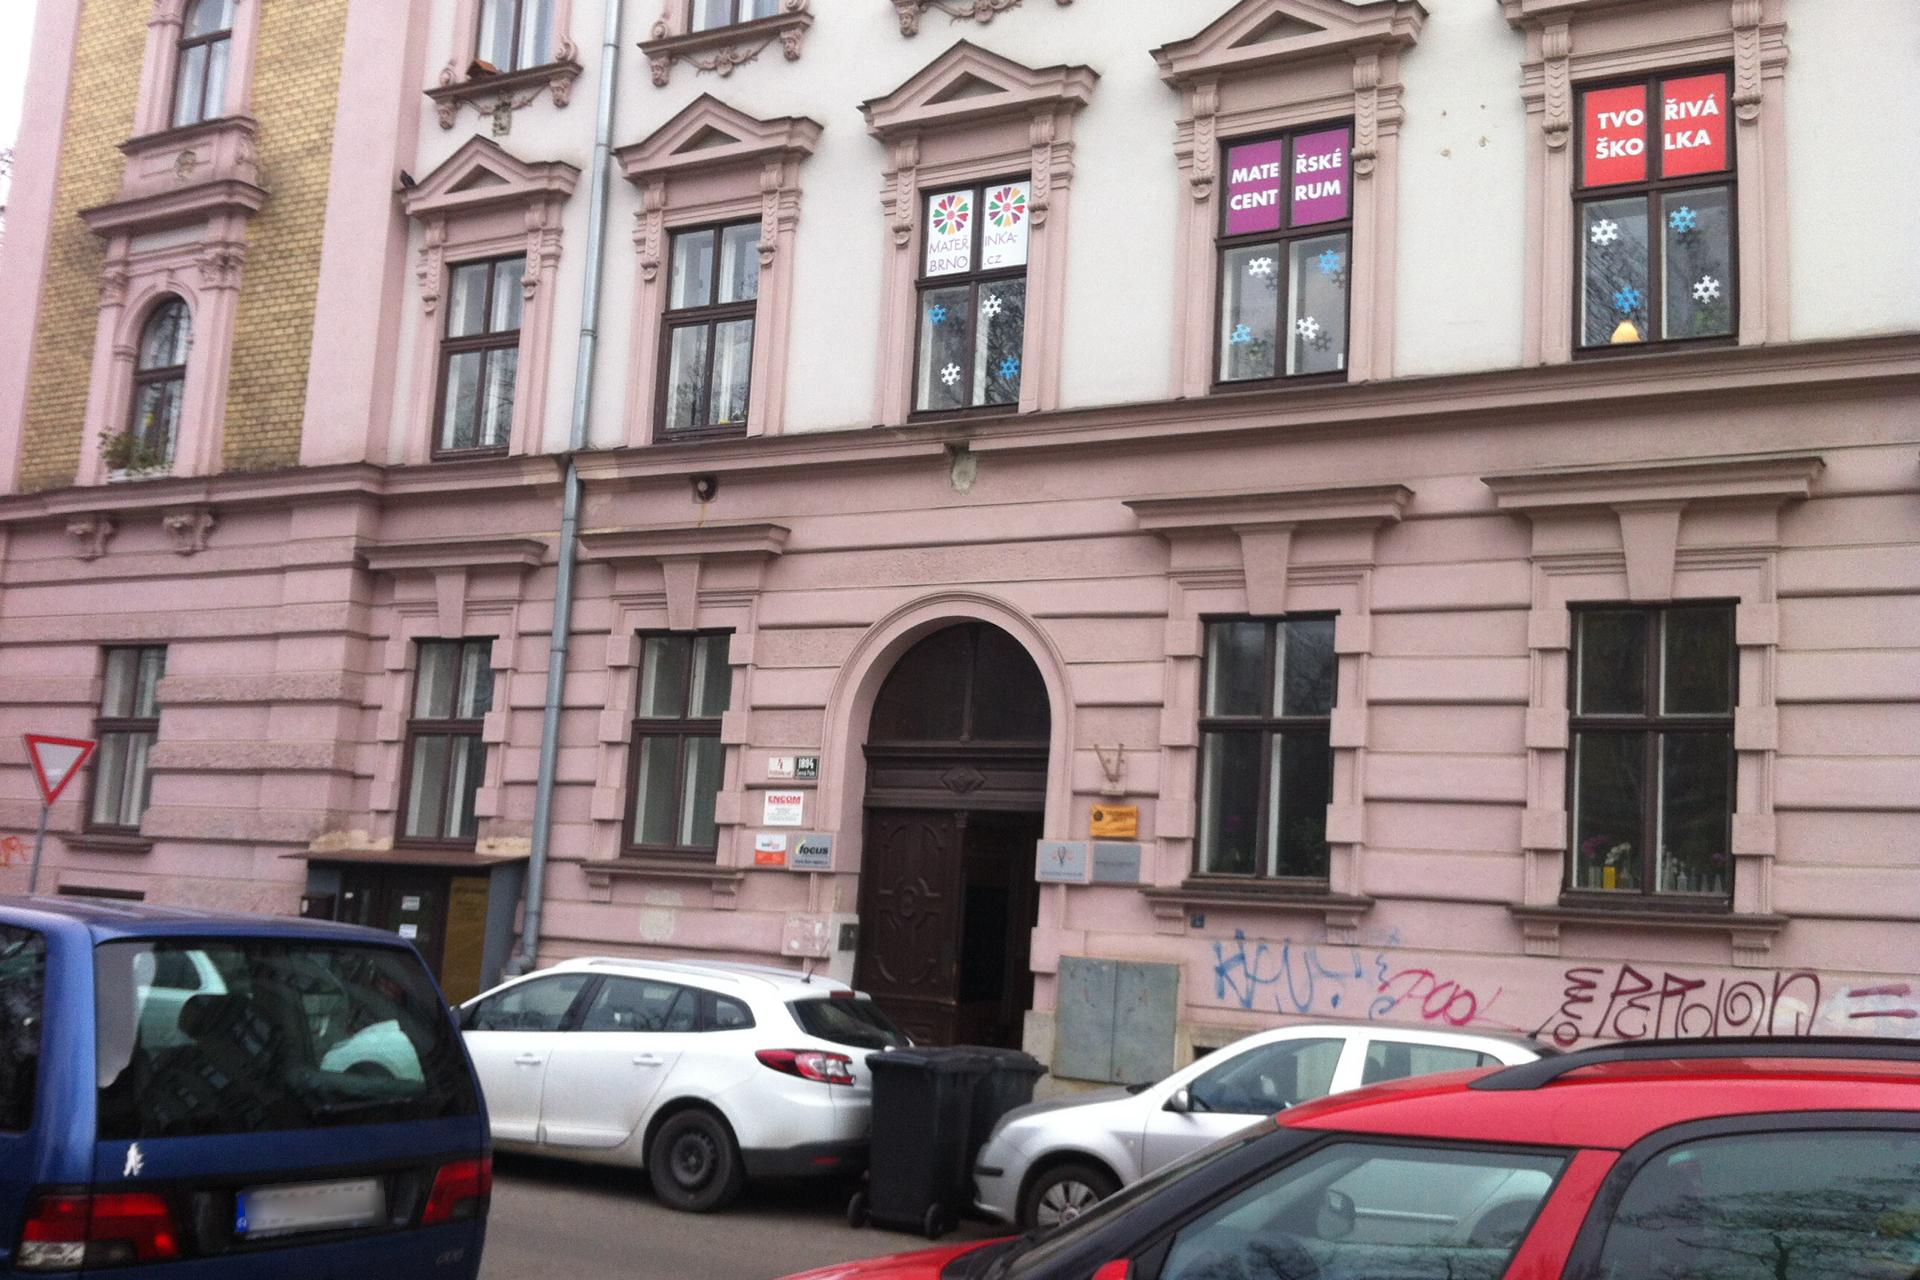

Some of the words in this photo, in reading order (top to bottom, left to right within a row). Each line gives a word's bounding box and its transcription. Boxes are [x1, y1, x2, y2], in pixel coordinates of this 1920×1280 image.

[1597, 108, 1645, 130] TVO
[1664, 93, 1719, 121] ŘIVÁ
[1595, 136, 1645, 160] ŠKO
[1664, 129, 1712, 150] LKA
[1231, 162, 1280, 184] MATE
[1295, 148, 1342, 174] ŘSKÉ
[1230, 189, 1278, 211] CENT
[1295, 179, 1341, 201] RUM
[928, 255, 969, 273] BRNO
[799, 843, 829, 855] focus
